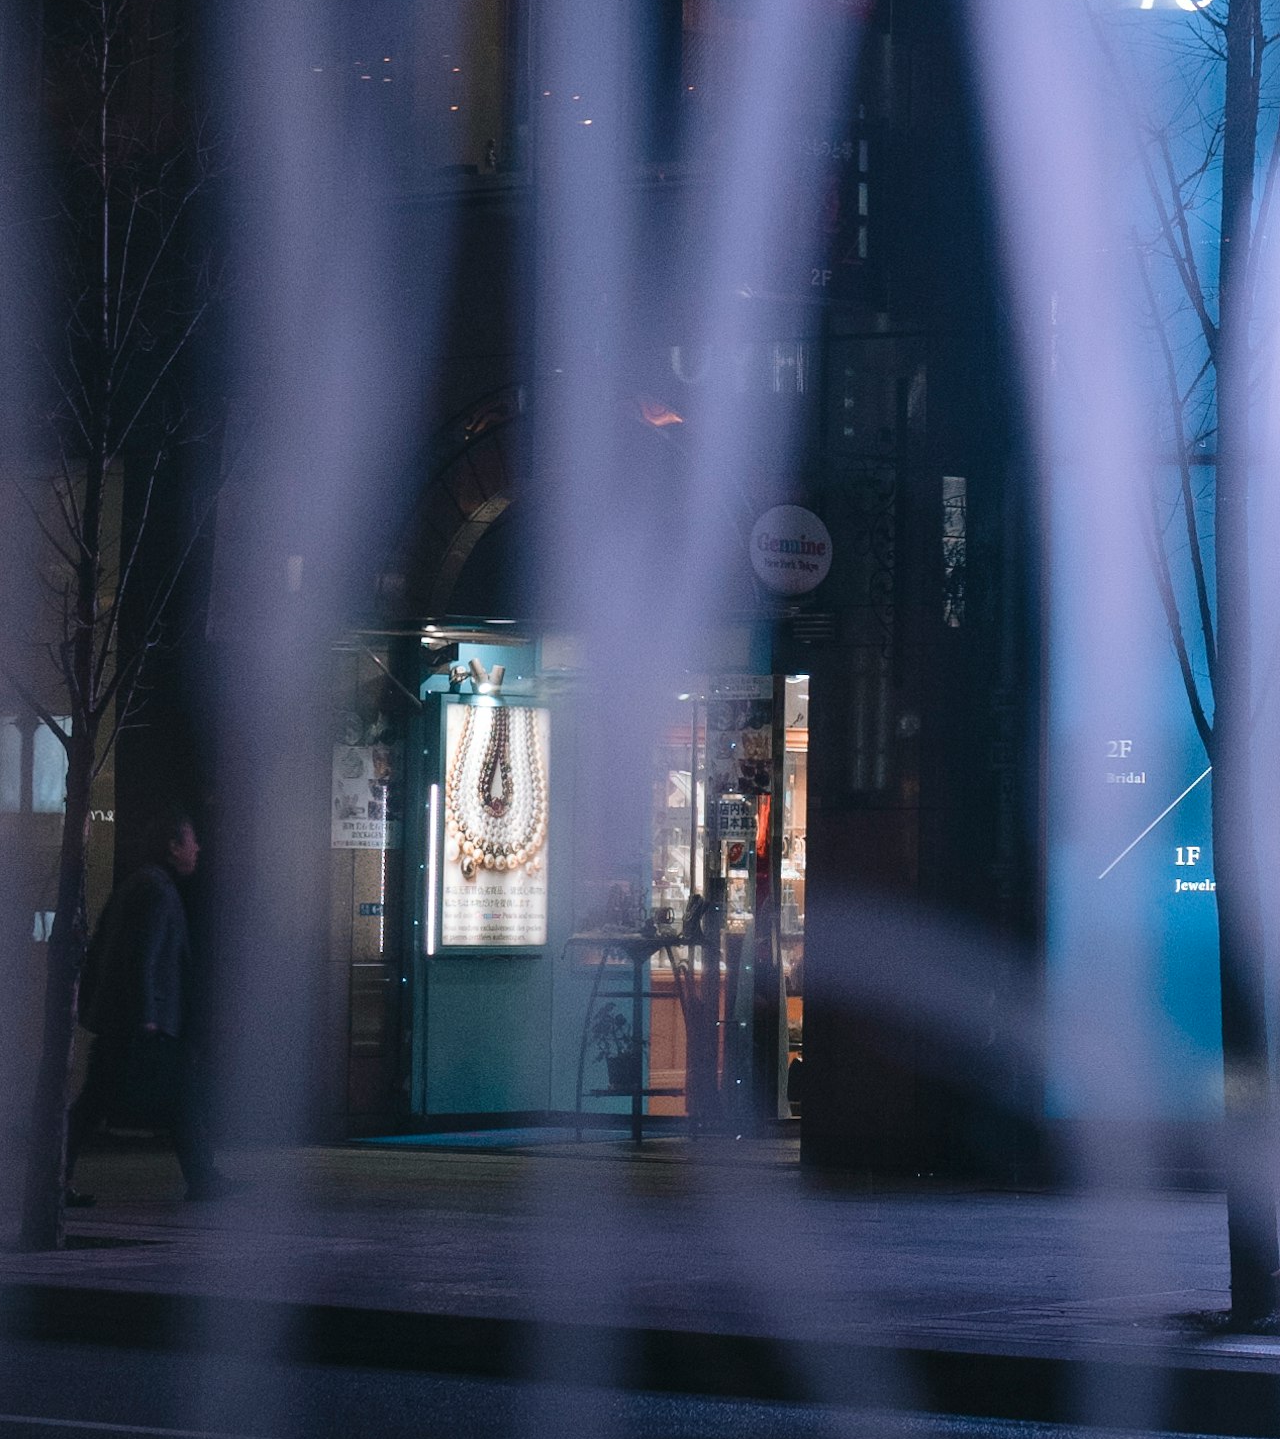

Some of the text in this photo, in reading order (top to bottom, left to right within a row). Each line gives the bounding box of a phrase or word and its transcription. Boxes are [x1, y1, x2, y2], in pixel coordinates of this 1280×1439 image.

[756, 532, 826, 556] Genuine
[1106, 739, 1133, 758] 2F
[1106, 771, 1147, 784] Bridal
[1174, 845, 1202, 866] 1F
[1174, 879, 1217, 893] Jewelr
